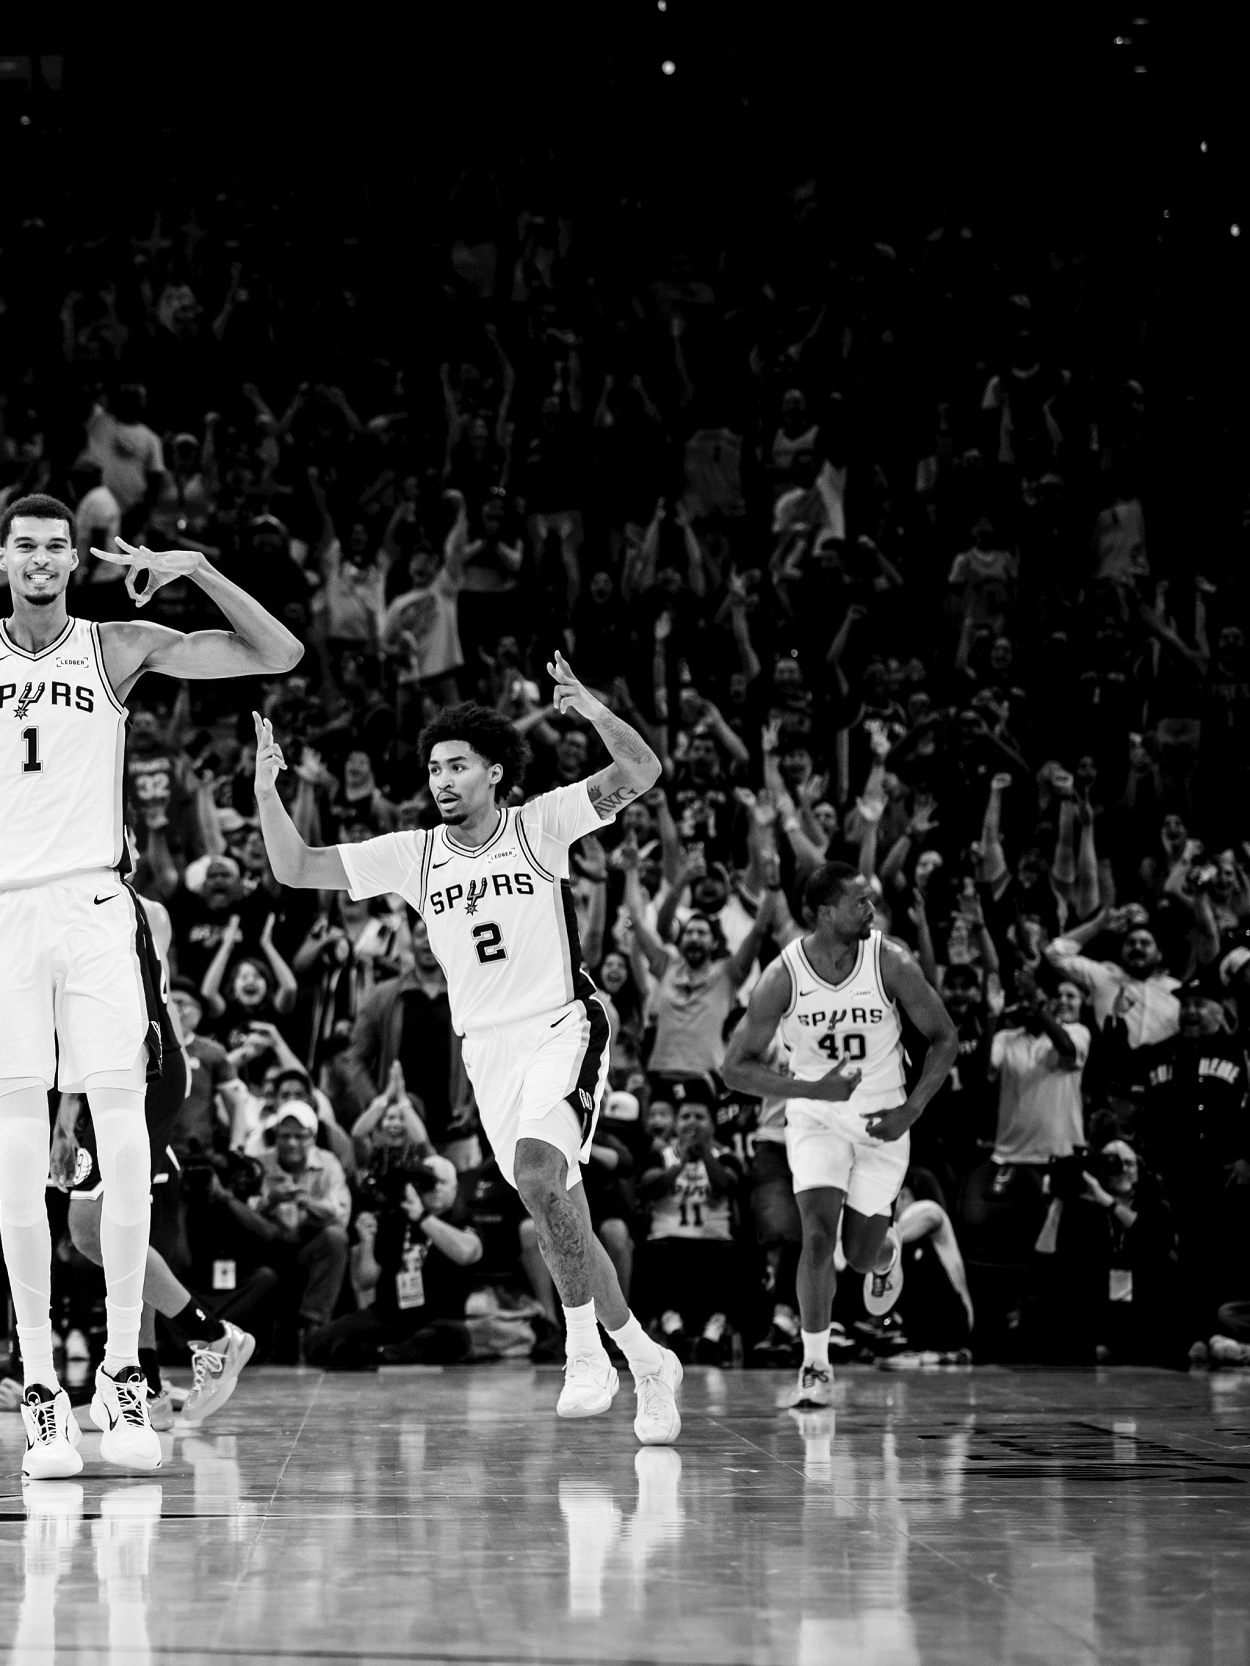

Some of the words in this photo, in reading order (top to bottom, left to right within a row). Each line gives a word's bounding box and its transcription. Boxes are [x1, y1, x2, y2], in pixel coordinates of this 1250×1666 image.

[21, 726, 43, 774] 1
[136, 773, 171, 800] 32
[491, 851, 513, 860] LEDGER
[430, 873, 534, 916] SPURS
[471, 921, 509, 966] 2
[797, 1007, 882, 1032] SPURS
[818, 1033, 866, 1060] 40
